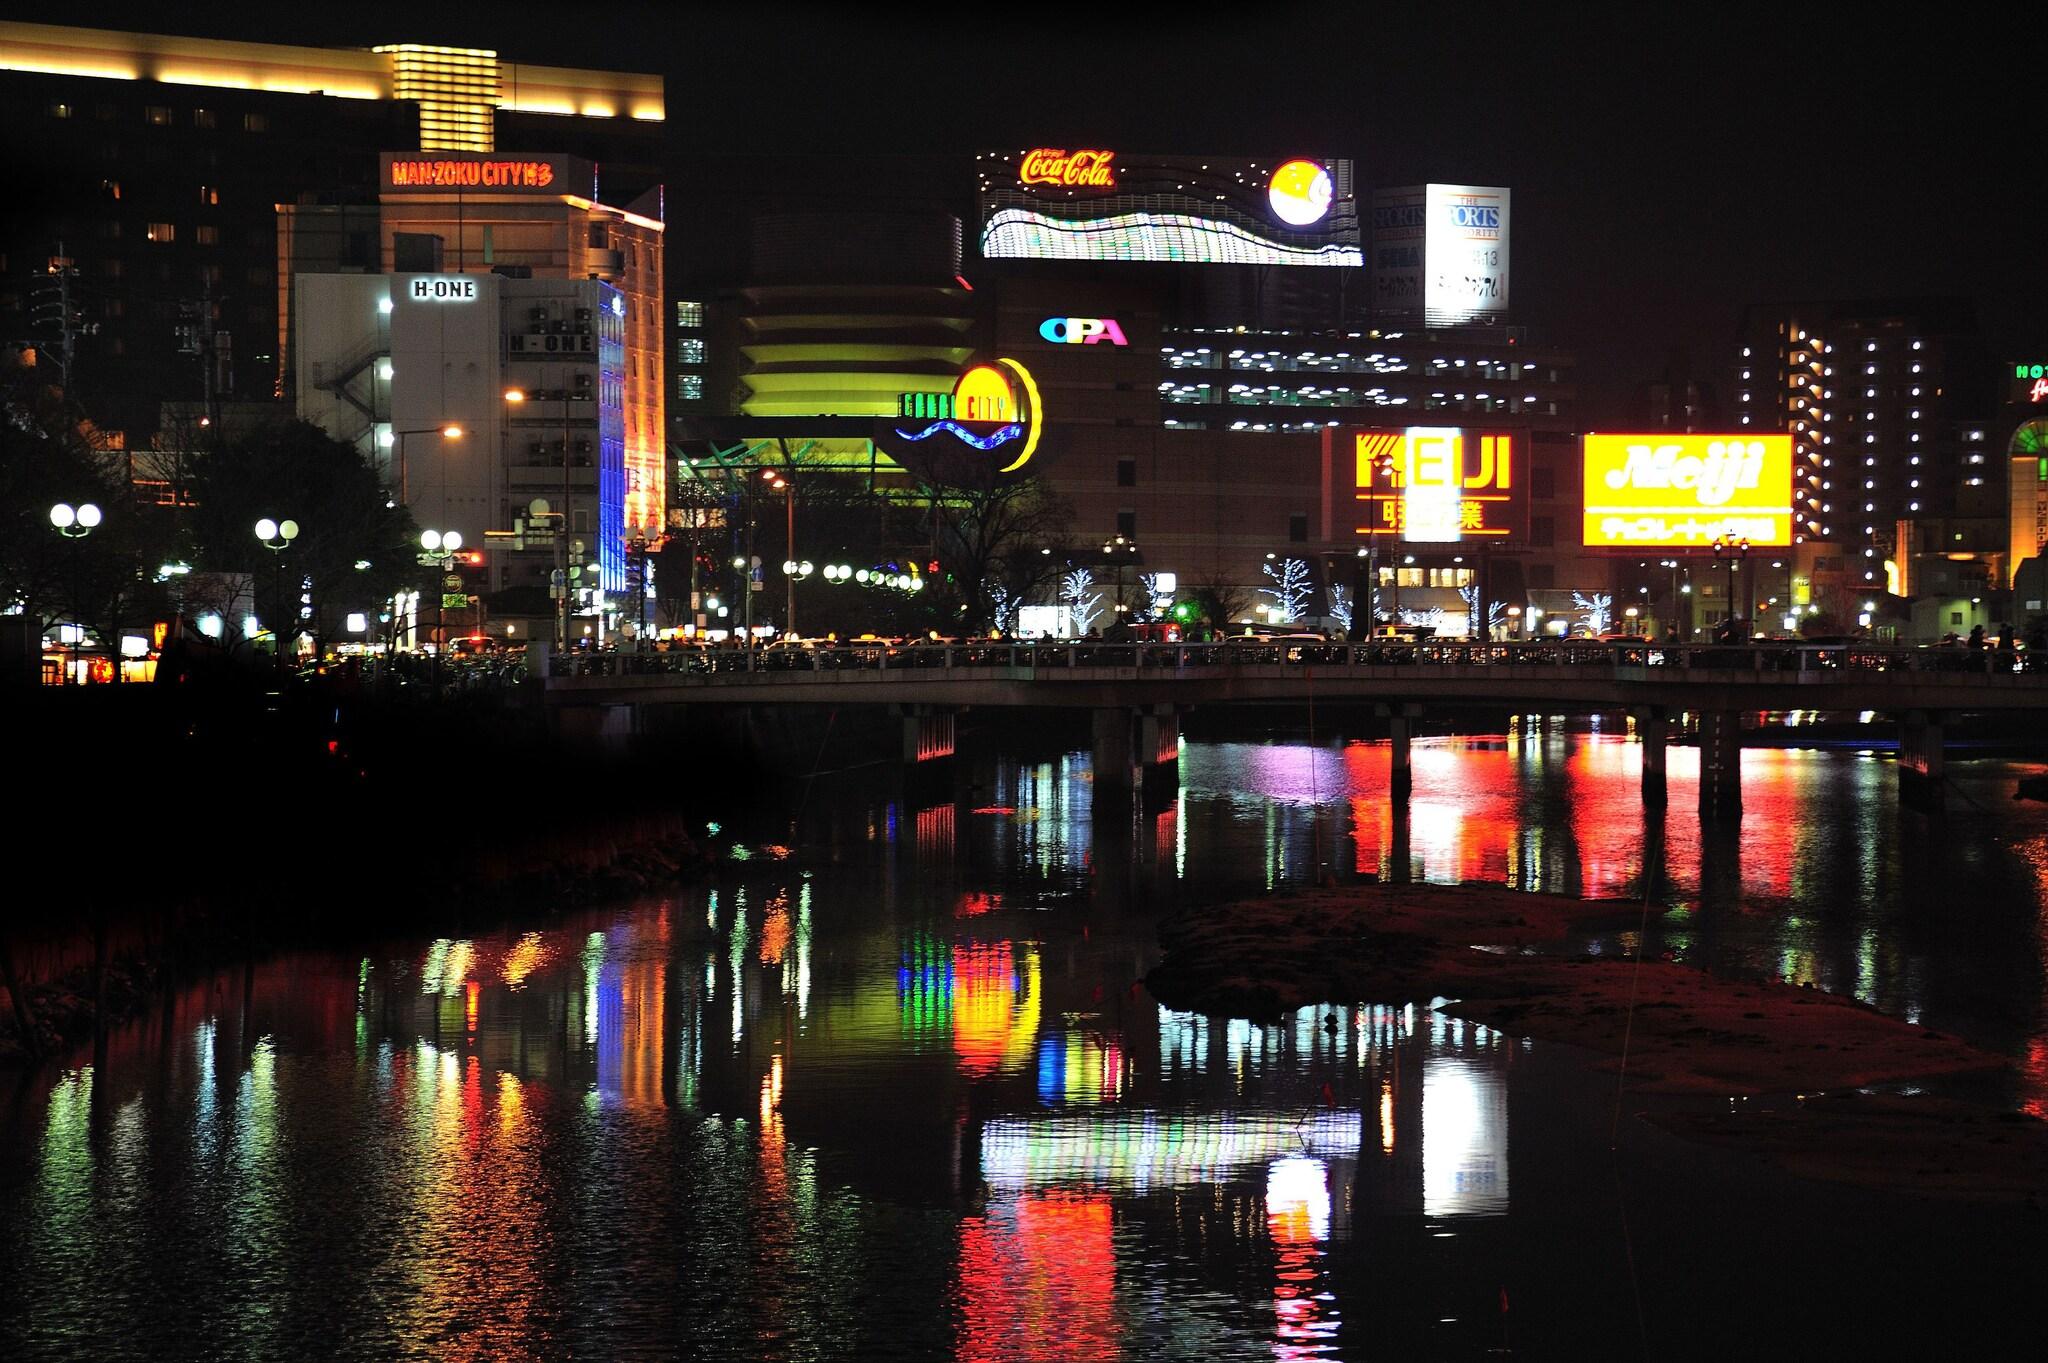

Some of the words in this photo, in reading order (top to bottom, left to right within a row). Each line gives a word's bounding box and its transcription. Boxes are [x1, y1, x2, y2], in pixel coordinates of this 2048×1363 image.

[482, 162, 522, 186] CITY
[1021, 149, 1115, 185] Coca-Cola
[414, 281, 475, 298] H-ONE
[1039, 317, 1129, 346] OPA
[968, 396, 1004, 420] CITY
[1383, 501, 1483, 529] 明業
